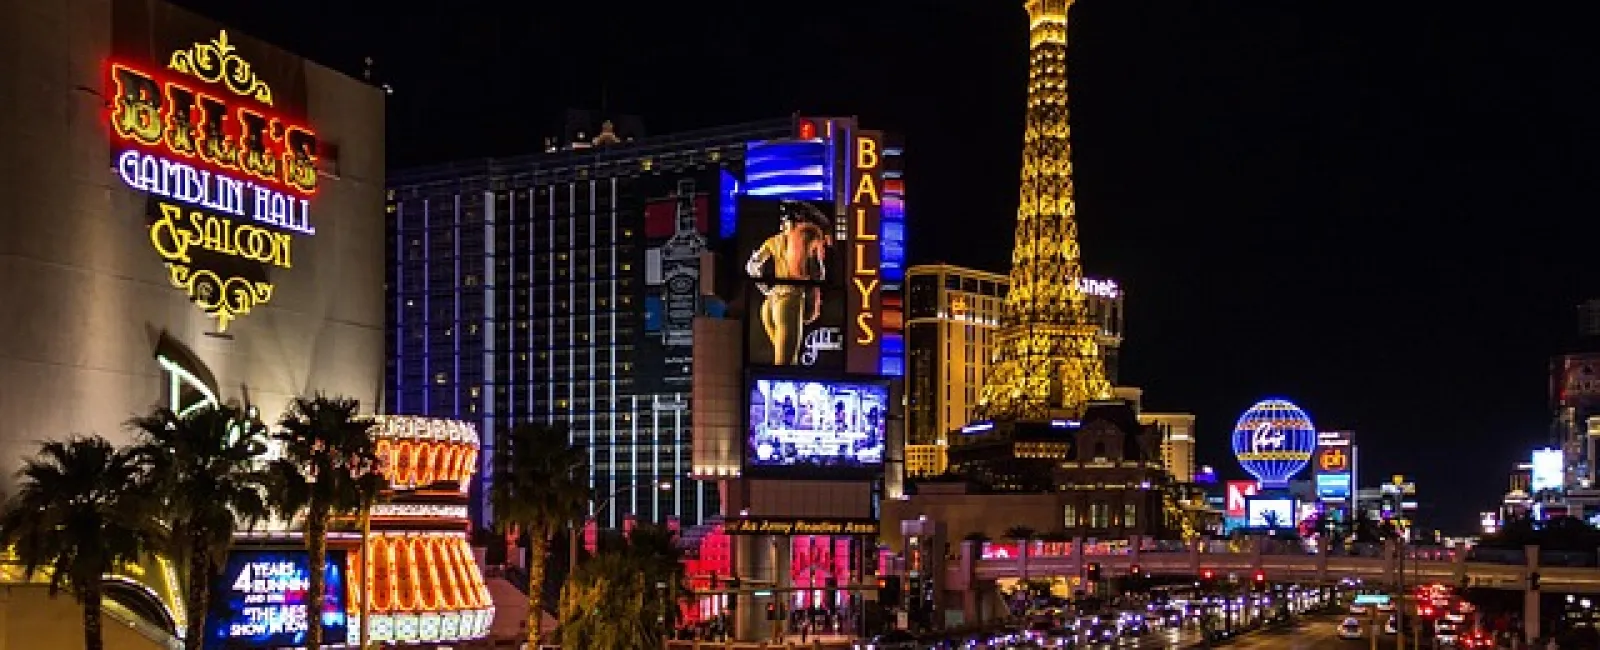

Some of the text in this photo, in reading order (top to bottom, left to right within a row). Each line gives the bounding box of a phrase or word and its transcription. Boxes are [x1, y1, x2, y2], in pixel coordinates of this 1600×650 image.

[111, 63, 318, 193] BILL'S
[150, 202, 291, 268] & SALOON
[253, 185, 315, 235] HALL
[853, 137, 881, 345] BALLYS
[1079, 278, 1118, 298] anet
[232, 562, 297, 592] 4 YEARS
